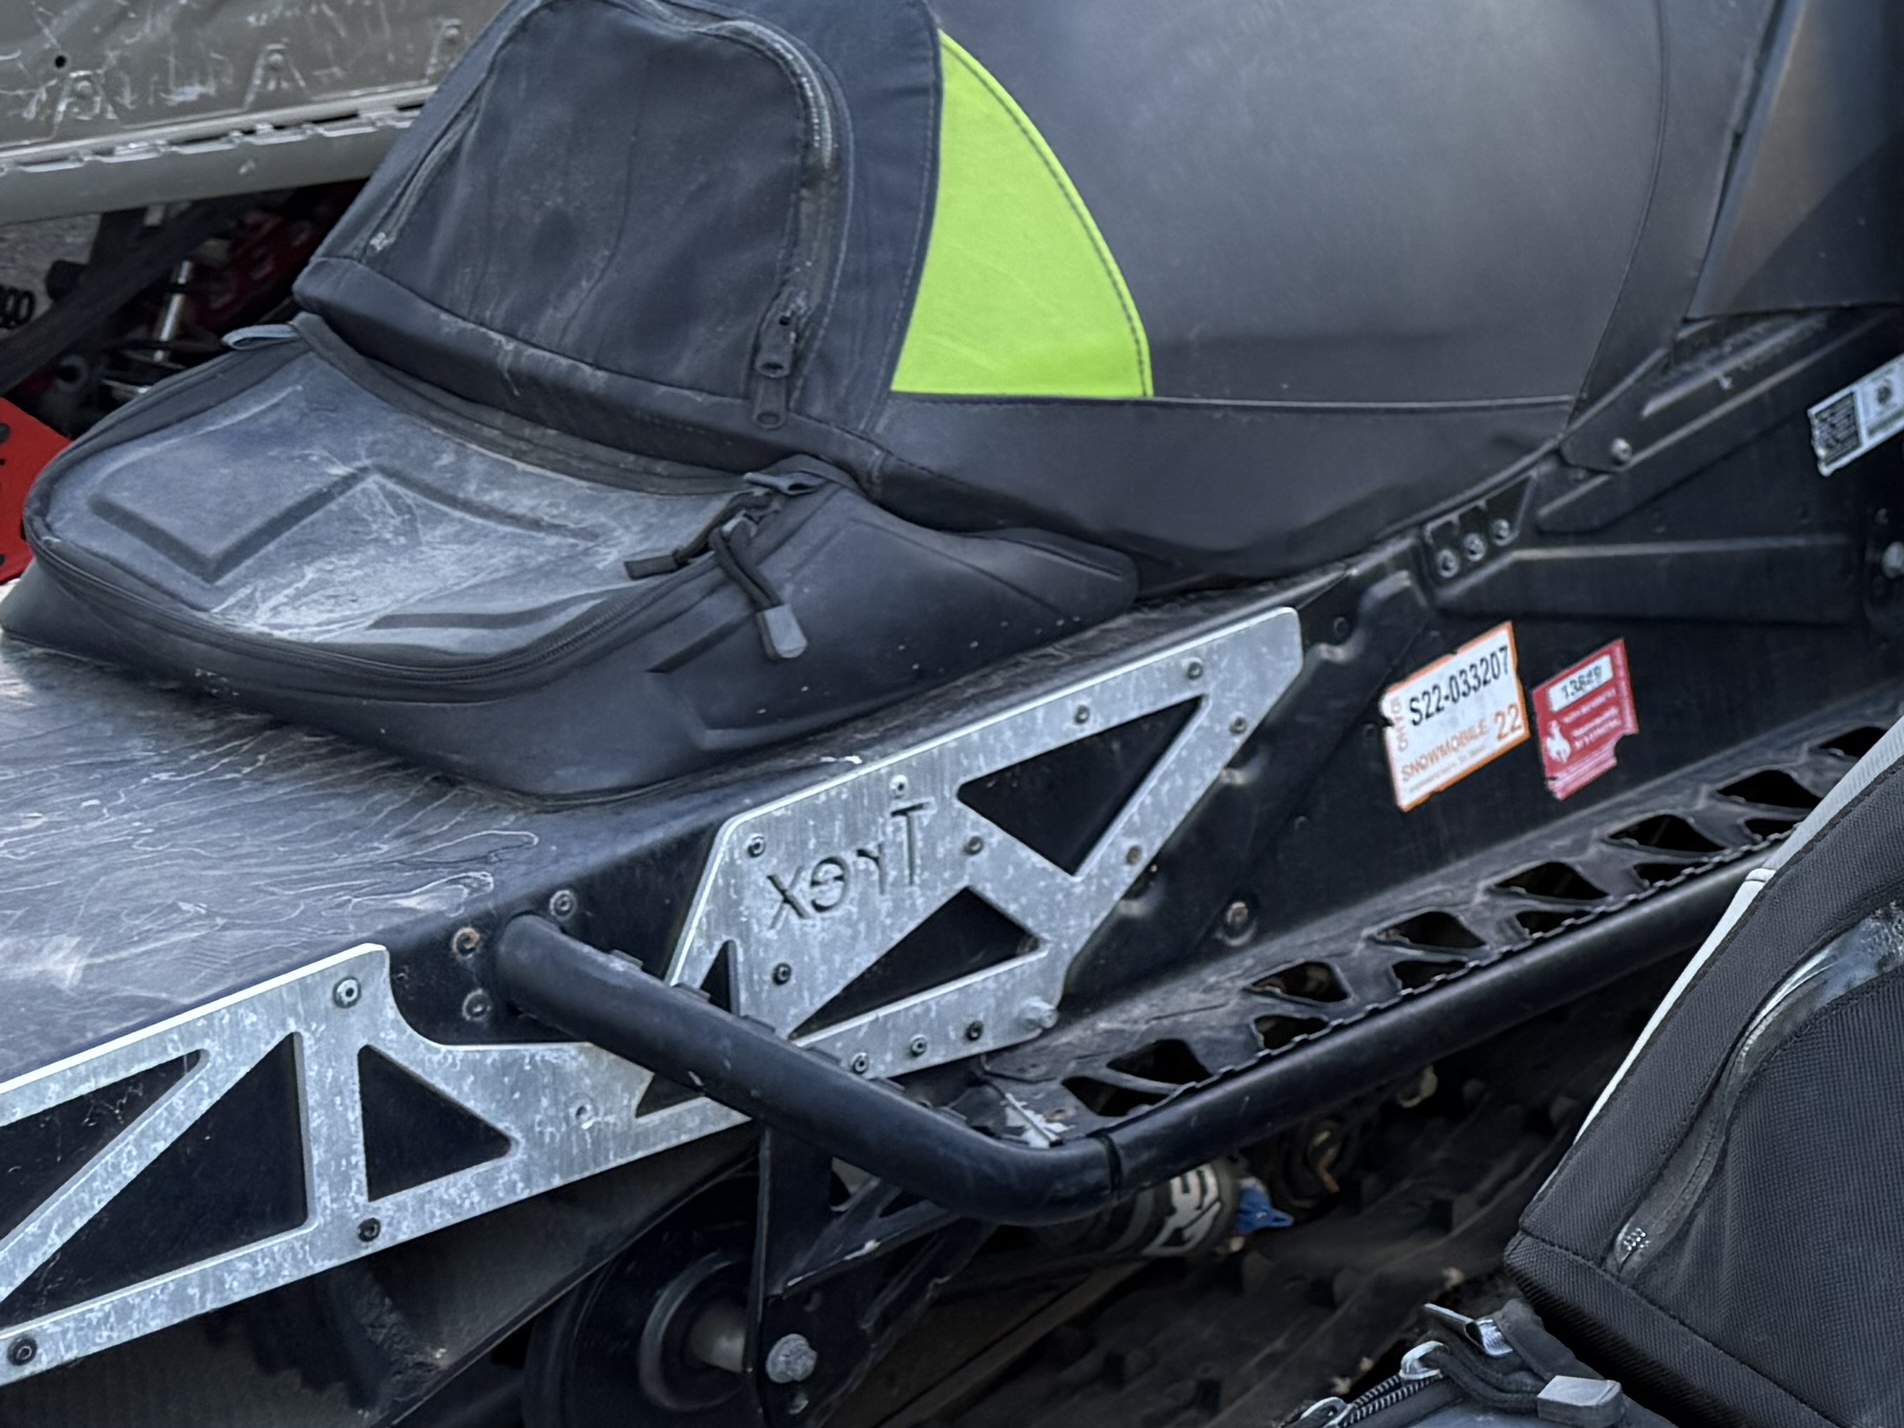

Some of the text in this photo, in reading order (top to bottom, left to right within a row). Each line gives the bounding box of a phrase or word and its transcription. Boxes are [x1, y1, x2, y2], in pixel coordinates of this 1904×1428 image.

[1408, 645, 1510, 726] S22-033207
[1401, 719, 1490, 783] SNOWMOBILE
[1493, 703, 1523, 742] 22
